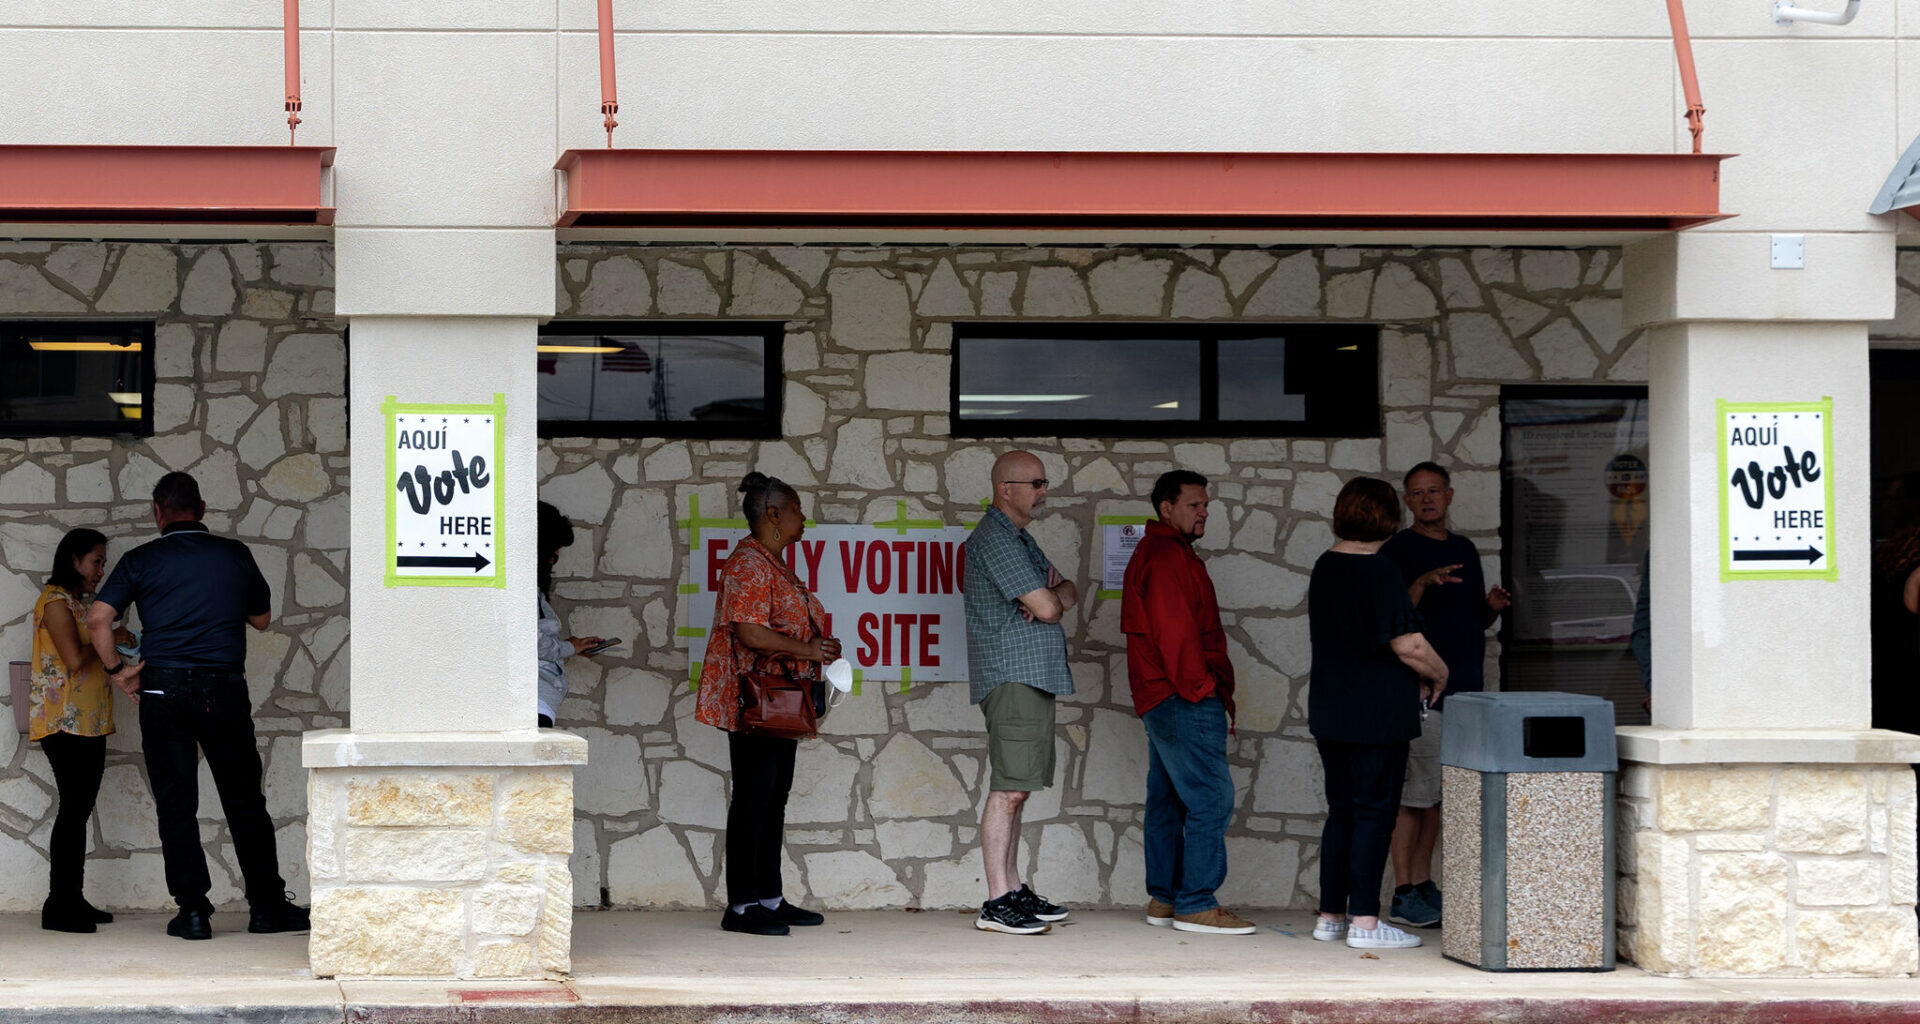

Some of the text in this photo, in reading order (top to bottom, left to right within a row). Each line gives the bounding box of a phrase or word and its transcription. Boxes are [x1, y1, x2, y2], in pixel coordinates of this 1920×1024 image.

[398, 426, 447, 450] AQUÍ
[1731, 422, 1778, 446] AQUÍ
[397, 450, 490, 515] Vote
[1731, 445, 1820, 509] Vote
[440, 516, 491, 535] HERE
[1774, 510, 1824, 528] HERE
[857, 612, 941, 667] SITE
